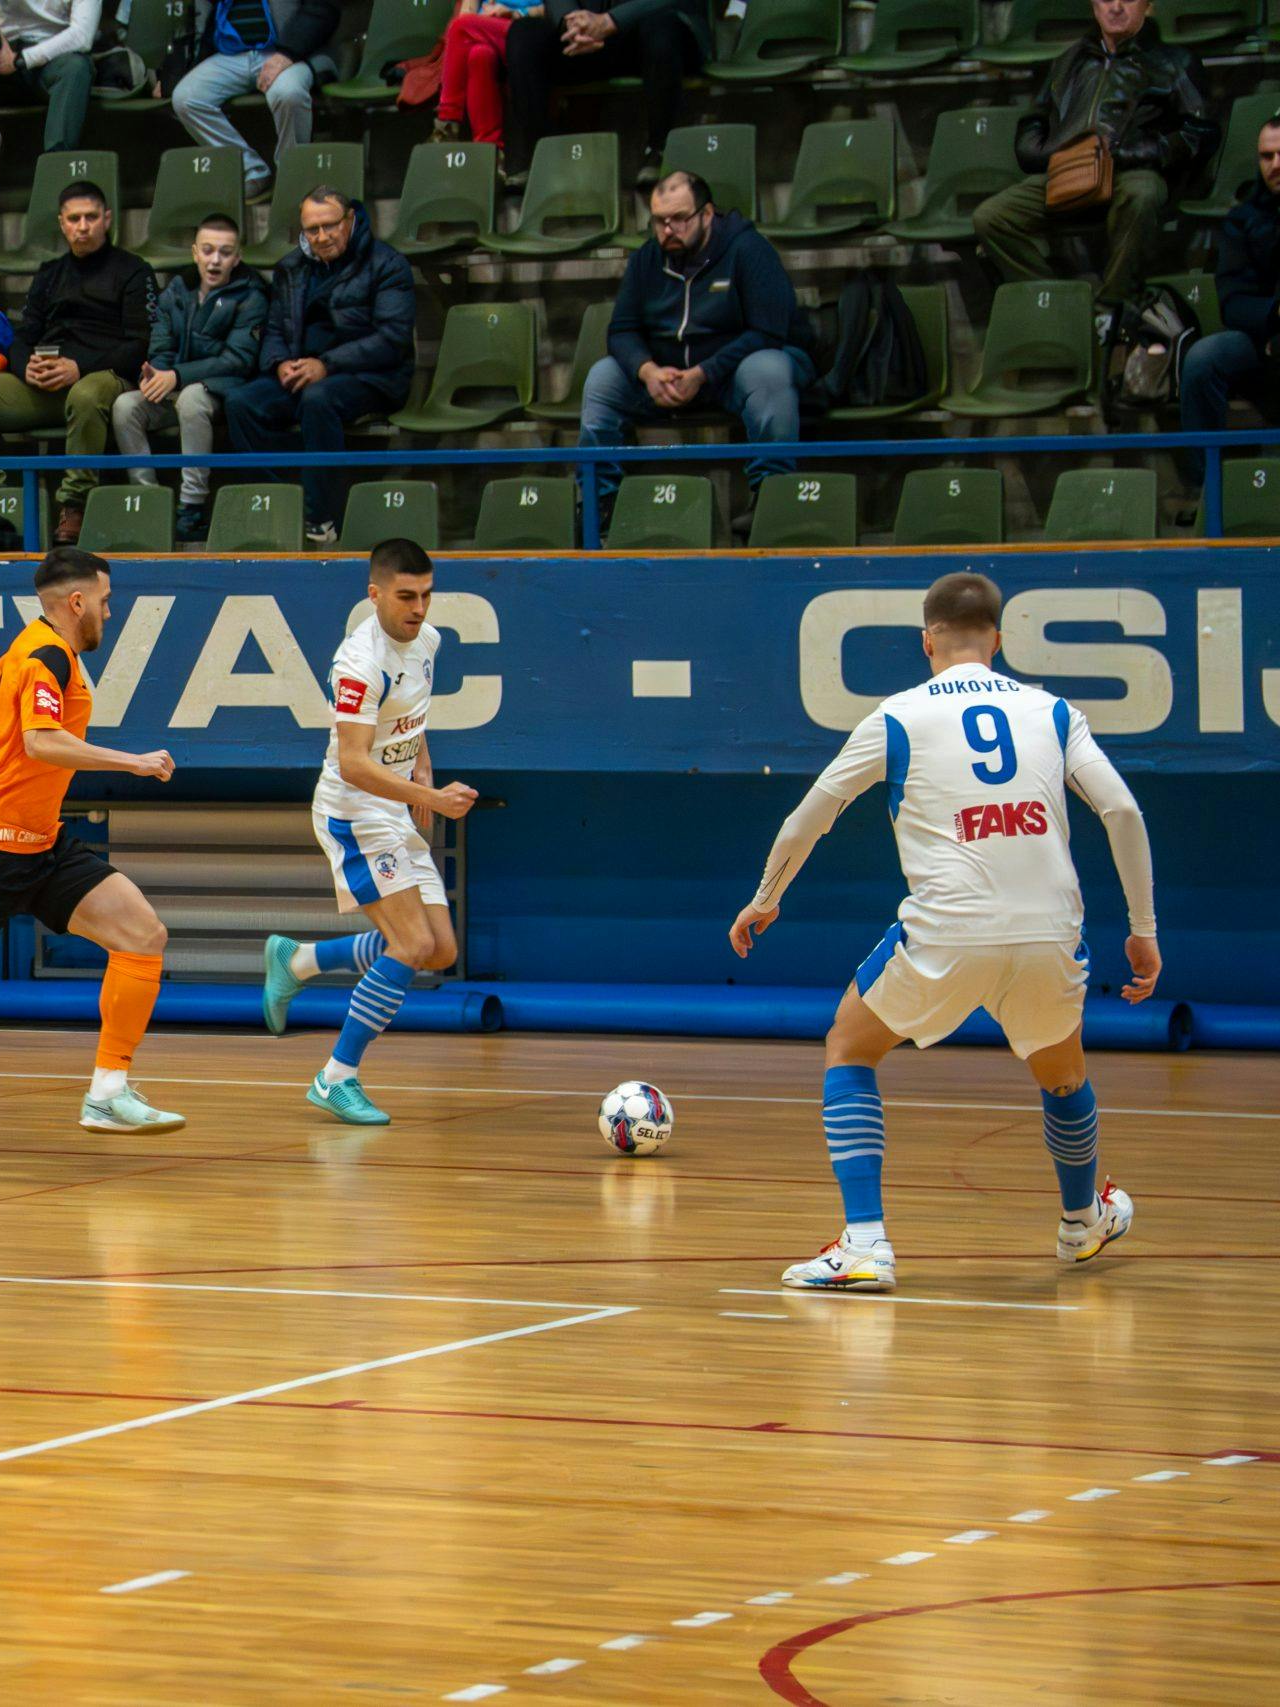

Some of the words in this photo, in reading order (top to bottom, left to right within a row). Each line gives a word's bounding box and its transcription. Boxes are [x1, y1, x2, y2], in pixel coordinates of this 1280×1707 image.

[166, 2, 185, 17] 13
[706, 135, 717, 152] 5
[192, 156, 211, 173] 12
[445, 151, 465, 168] 10
[69, 160, 88, 177] 13
[1253, 470, 1266, 488] 3
[653, 484, 677, 504] 26
[797, 481, 821, 501] 22
[949, 480, 960, 497] 5
[124, 496, 140, 512] 11
[251, 495, 270, 512] 21
[383, 491, 405, 508] 19
[928, 679, 1021, 697] BUKOVEC
[961, 704, 1018, 786] 9
[960, 800, 1049, 843] FAKS
